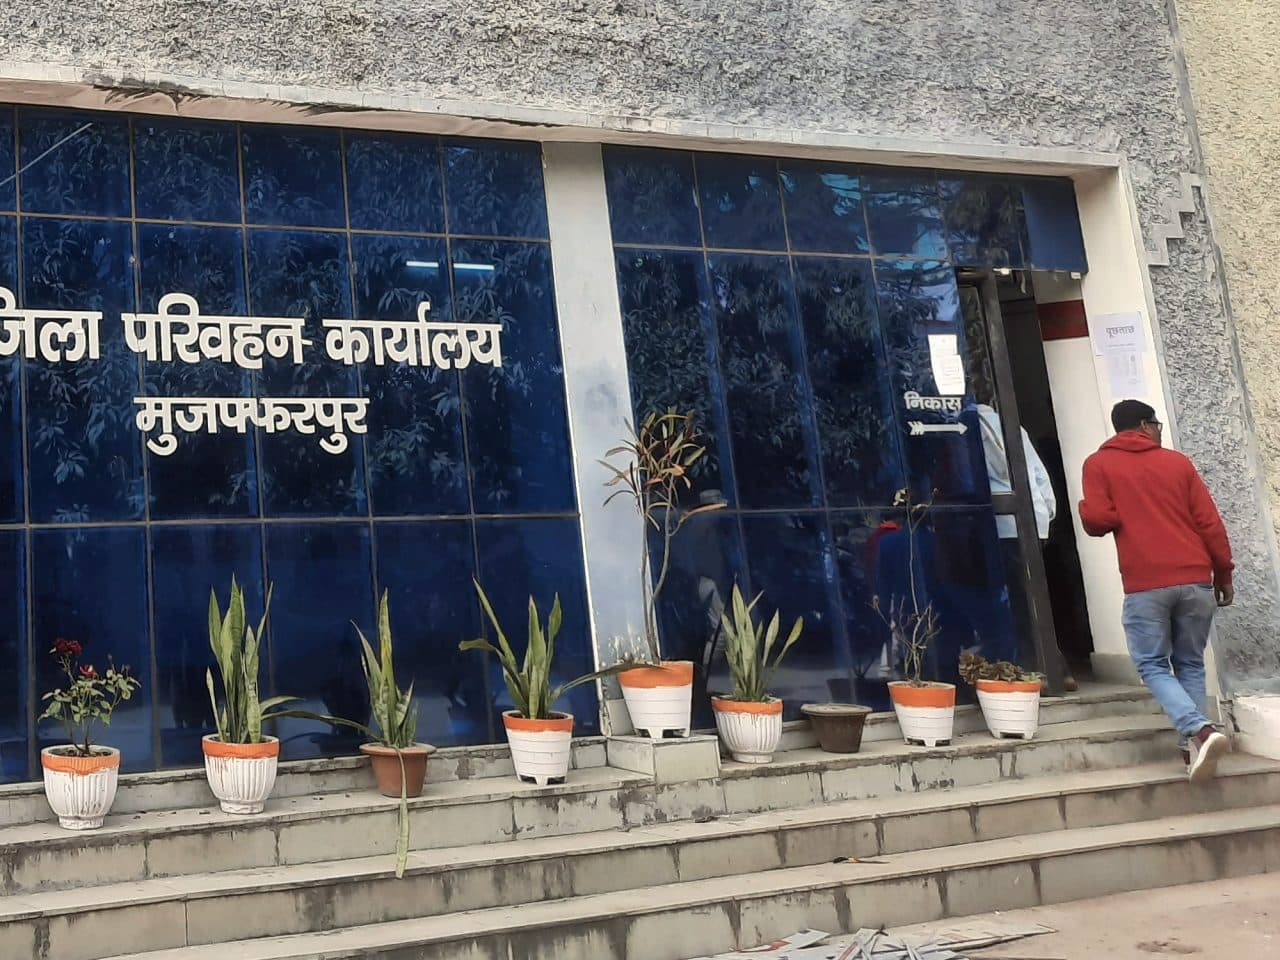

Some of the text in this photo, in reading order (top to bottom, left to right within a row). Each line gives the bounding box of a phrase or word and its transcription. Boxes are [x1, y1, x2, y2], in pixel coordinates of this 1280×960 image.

[121, 293, 312, 369] परिवहन
[322, 301, 502, 368] कार्यालय
[133, 396, 369, 456] मुजफ्फरपुर
[903, 390, 962, 411] निकास
